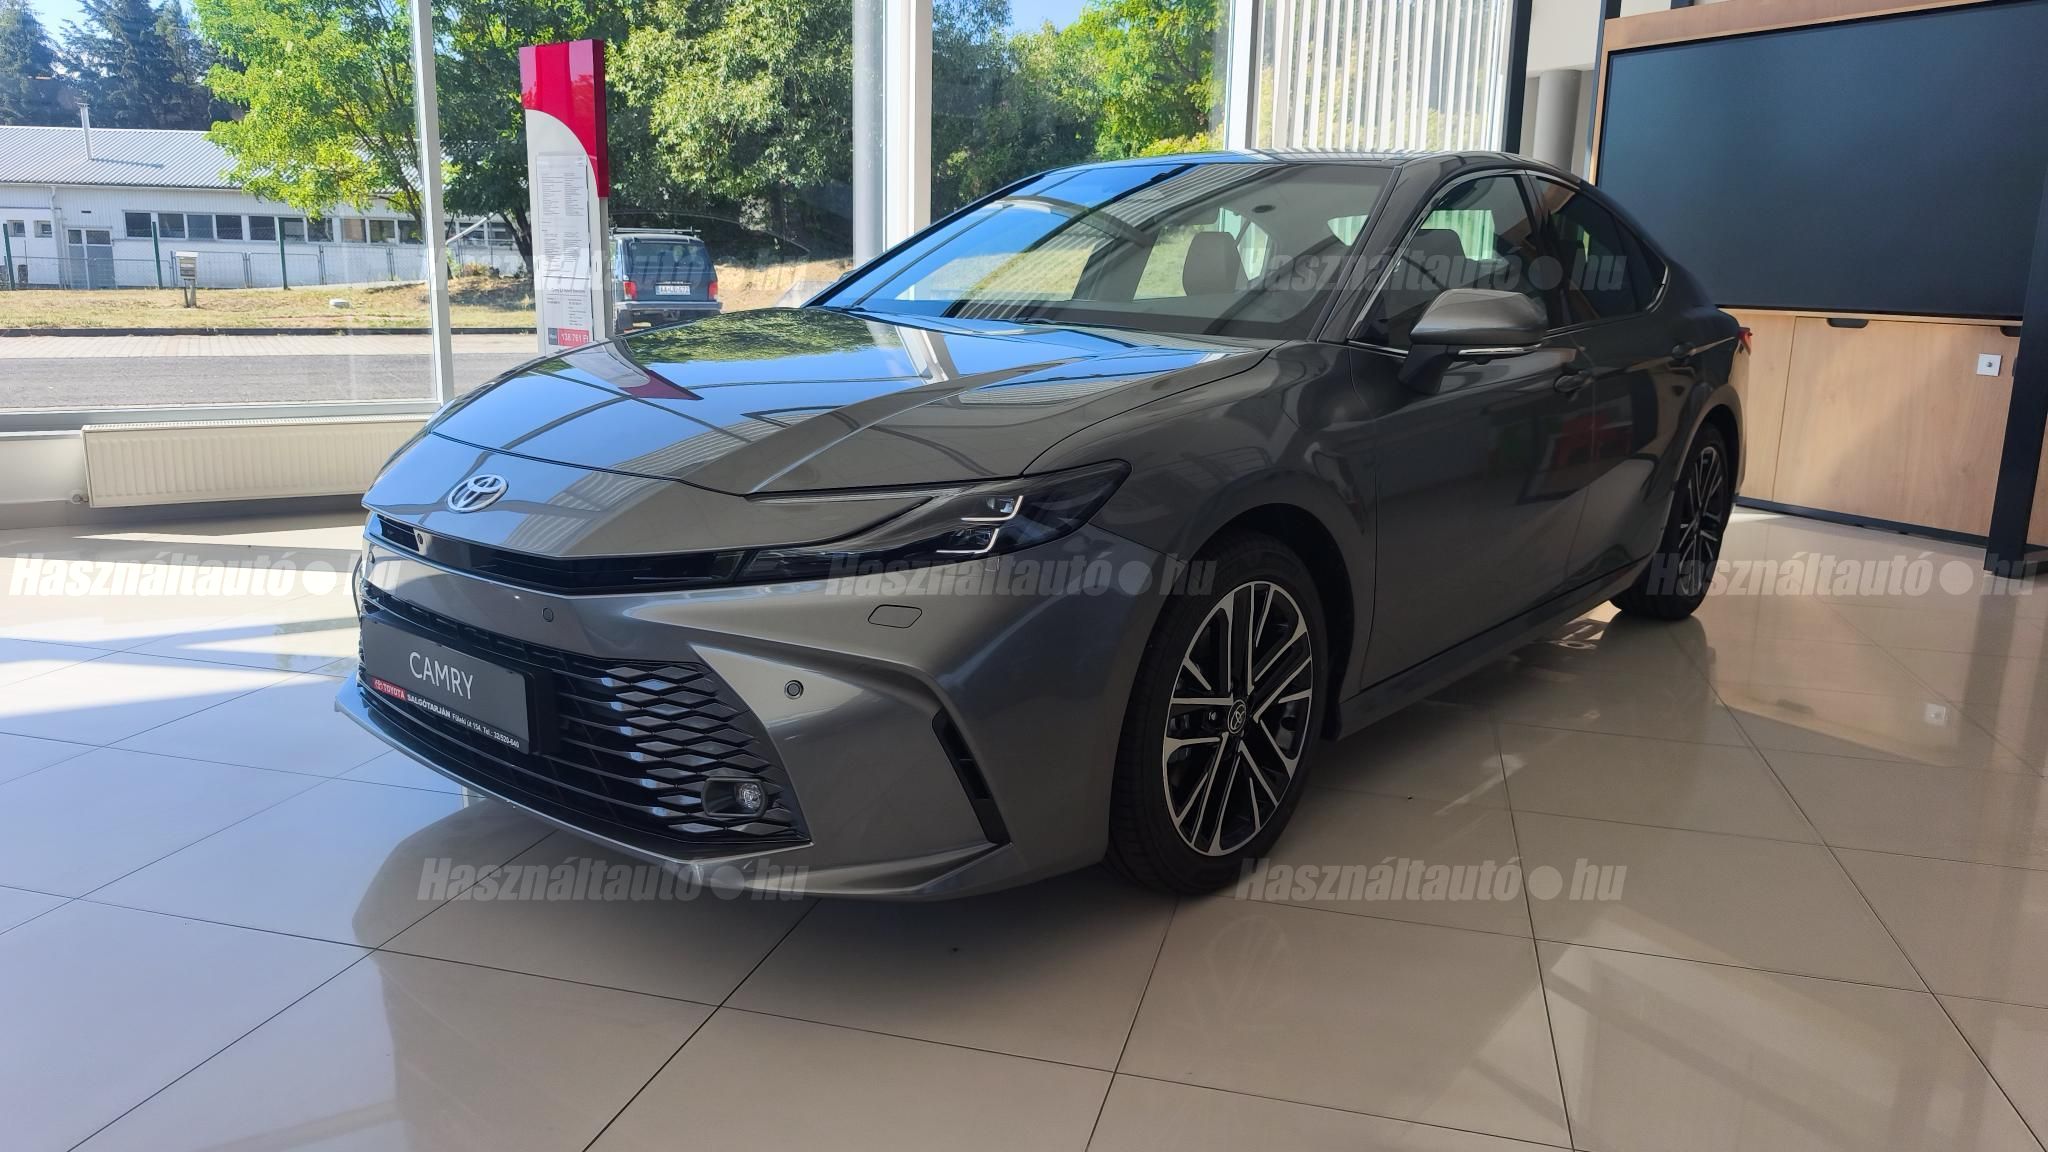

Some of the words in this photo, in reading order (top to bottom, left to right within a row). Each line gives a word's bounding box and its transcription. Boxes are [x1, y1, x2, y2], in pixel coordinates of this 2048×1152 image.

[409, 651, 474, 700] CAMRY
[382, 682, 405, 700] TOYOTA
[407, 694, 451, 718] SALGÓTARJÁN
